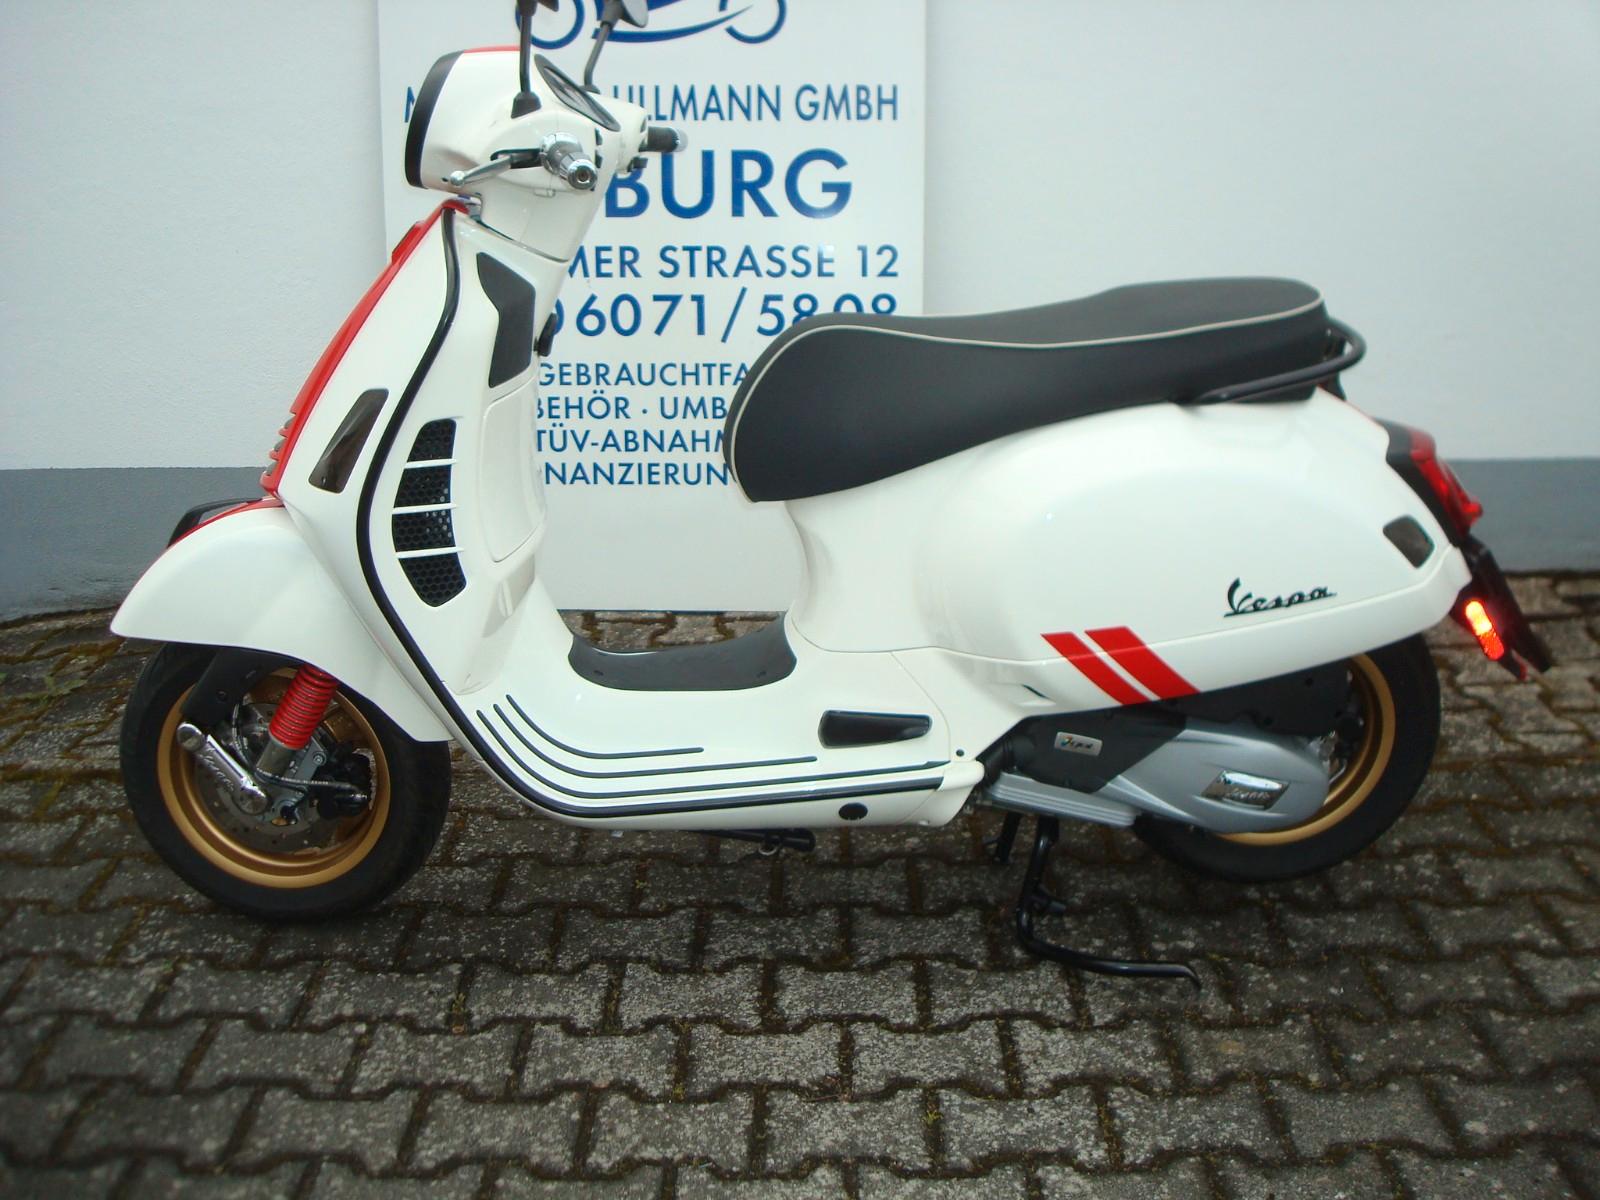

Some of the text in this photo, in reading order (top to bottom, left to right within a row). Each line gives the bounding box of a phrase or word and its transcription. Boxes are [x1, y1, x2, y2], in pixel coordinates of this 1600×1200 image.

[794, 82, 899, 122] GMBH
[604, 148, 853, 220] BURG
[658, 243, 837, 279] STRASSE
[857, 243, 900, 278] 12
[659, 394, 728, 421] UMB
[544, 460, 729, 486] NANZIERUN
[1223, 577, 1337, 617] Vespa
